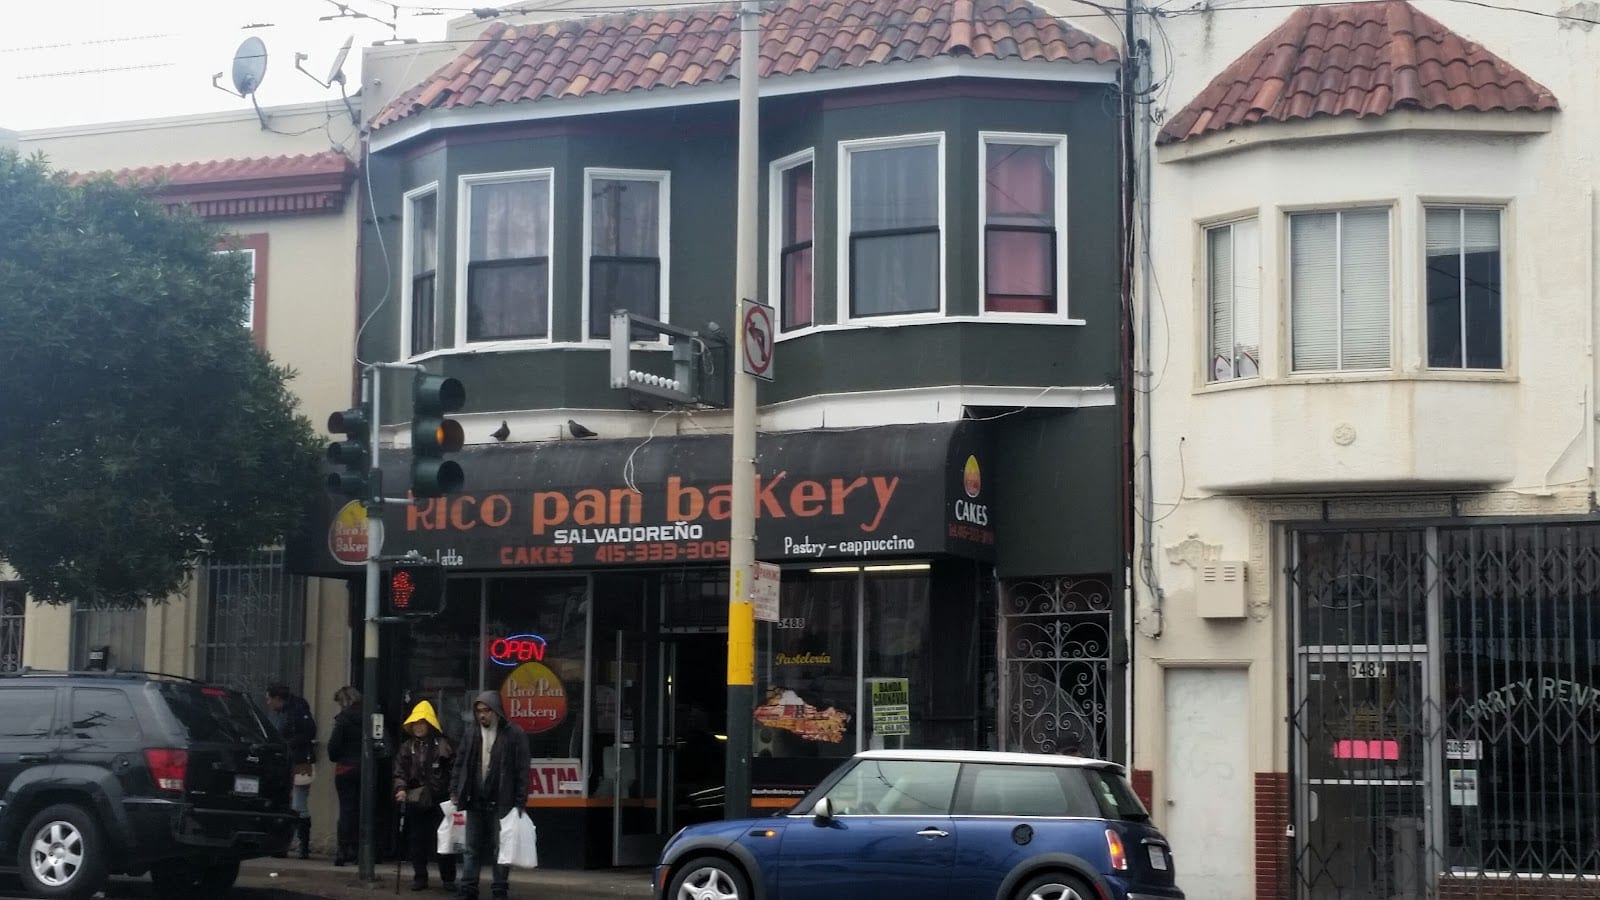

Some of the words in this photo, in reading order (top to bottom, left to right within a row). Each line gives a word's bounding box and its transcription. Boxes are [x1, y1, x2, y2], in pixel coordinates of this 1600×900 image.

[533, 488, 642, 535] pan
[955, 499, 988, 526] CAKES
[336, 537, 368, 552] Baker
[553, 521, 703, 545] SALVADOREÑO
[501, 546, 574, 565] CAKES
[595, 541, 730, 563] 415-333-309
[839, 534, 915, 556] cappuccino
[436, 549, 463, 566] latte
[490, 639, 545, 661] OPEN
[507, 679, 535, 697] Rico
[538, 678, 564, 697] Pan
[1465, 678, 1534, 720] PARTY
[510, 700, 557, 720] Bakery
[529, 767, 583, 795] ATM
